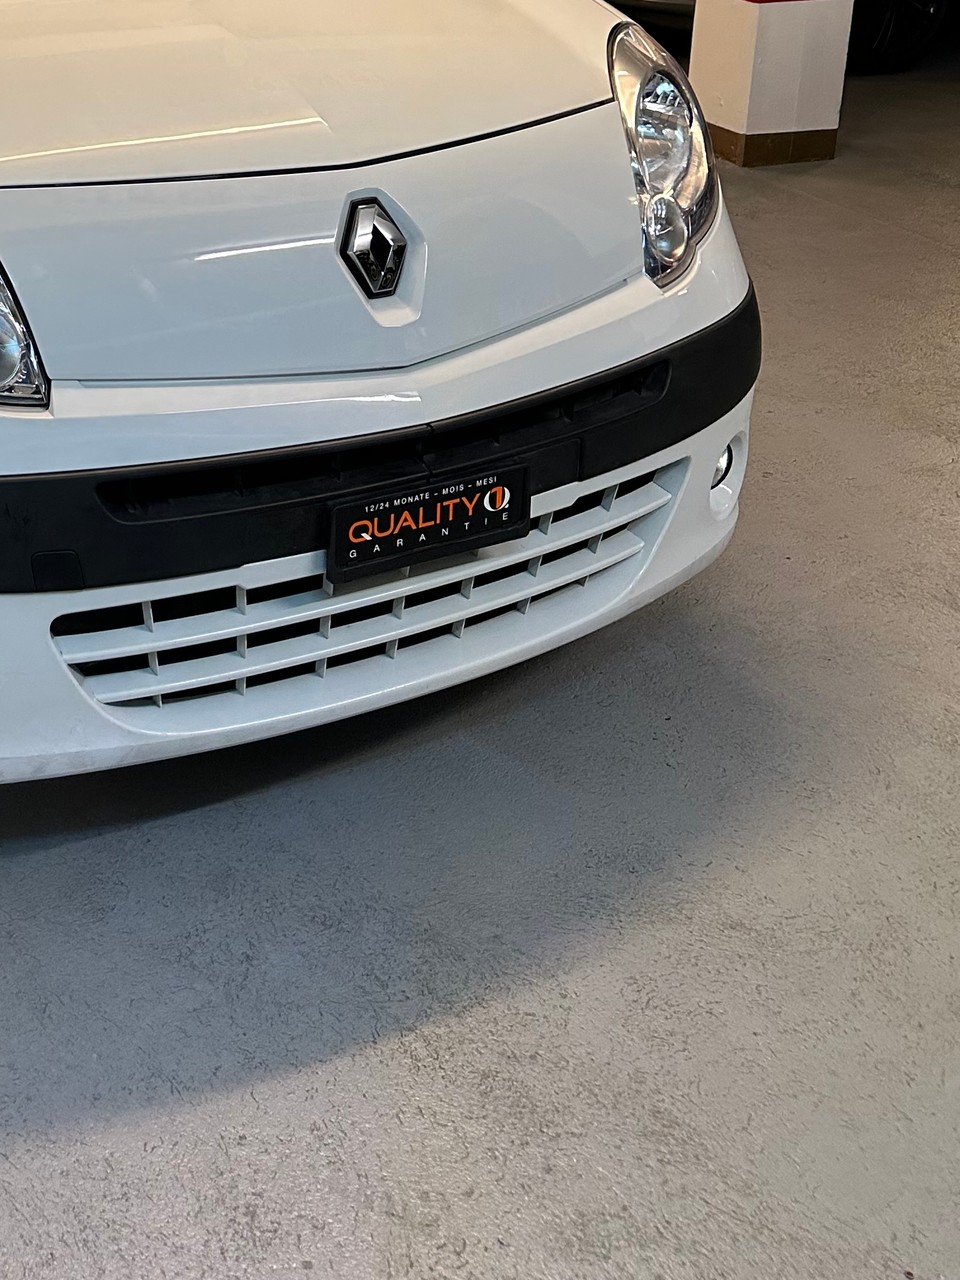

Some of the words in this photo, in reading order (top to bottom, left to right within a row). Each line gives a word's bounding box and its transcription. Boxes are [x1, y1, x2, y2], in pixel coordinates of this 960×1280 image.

[364, 501, 389, 513] 12/24
[393, 491, 430, 506] MONATE
[442, 484, 465, 495] MOIS
[476, 476, 497, 487] MESI
[349, 512, 509, 558] GARANTIE
